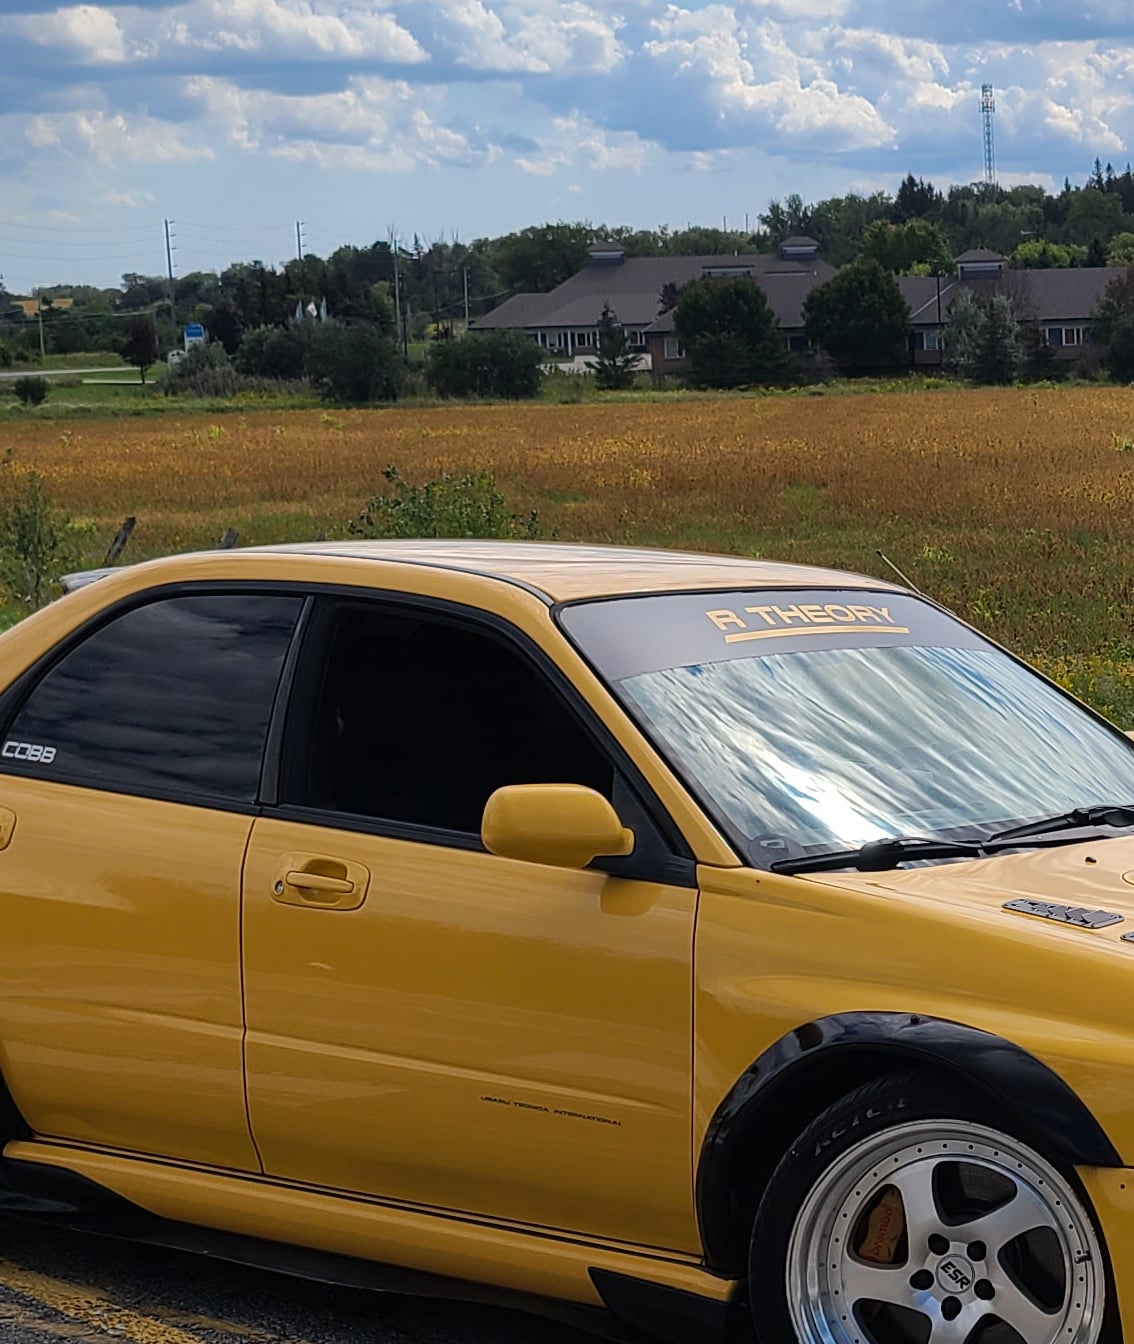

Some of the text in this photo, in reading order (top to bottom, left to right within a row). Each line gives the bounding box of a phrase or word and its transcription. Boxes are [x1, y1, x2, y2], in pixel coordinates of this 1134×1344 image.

[706, 604, 896, 631] R THEORY
[2, 741, 57, 764] COBB
[553, 1109, 622, 1126] INTERNATIONAL
[940, 1260, 971, 1290] ESR
